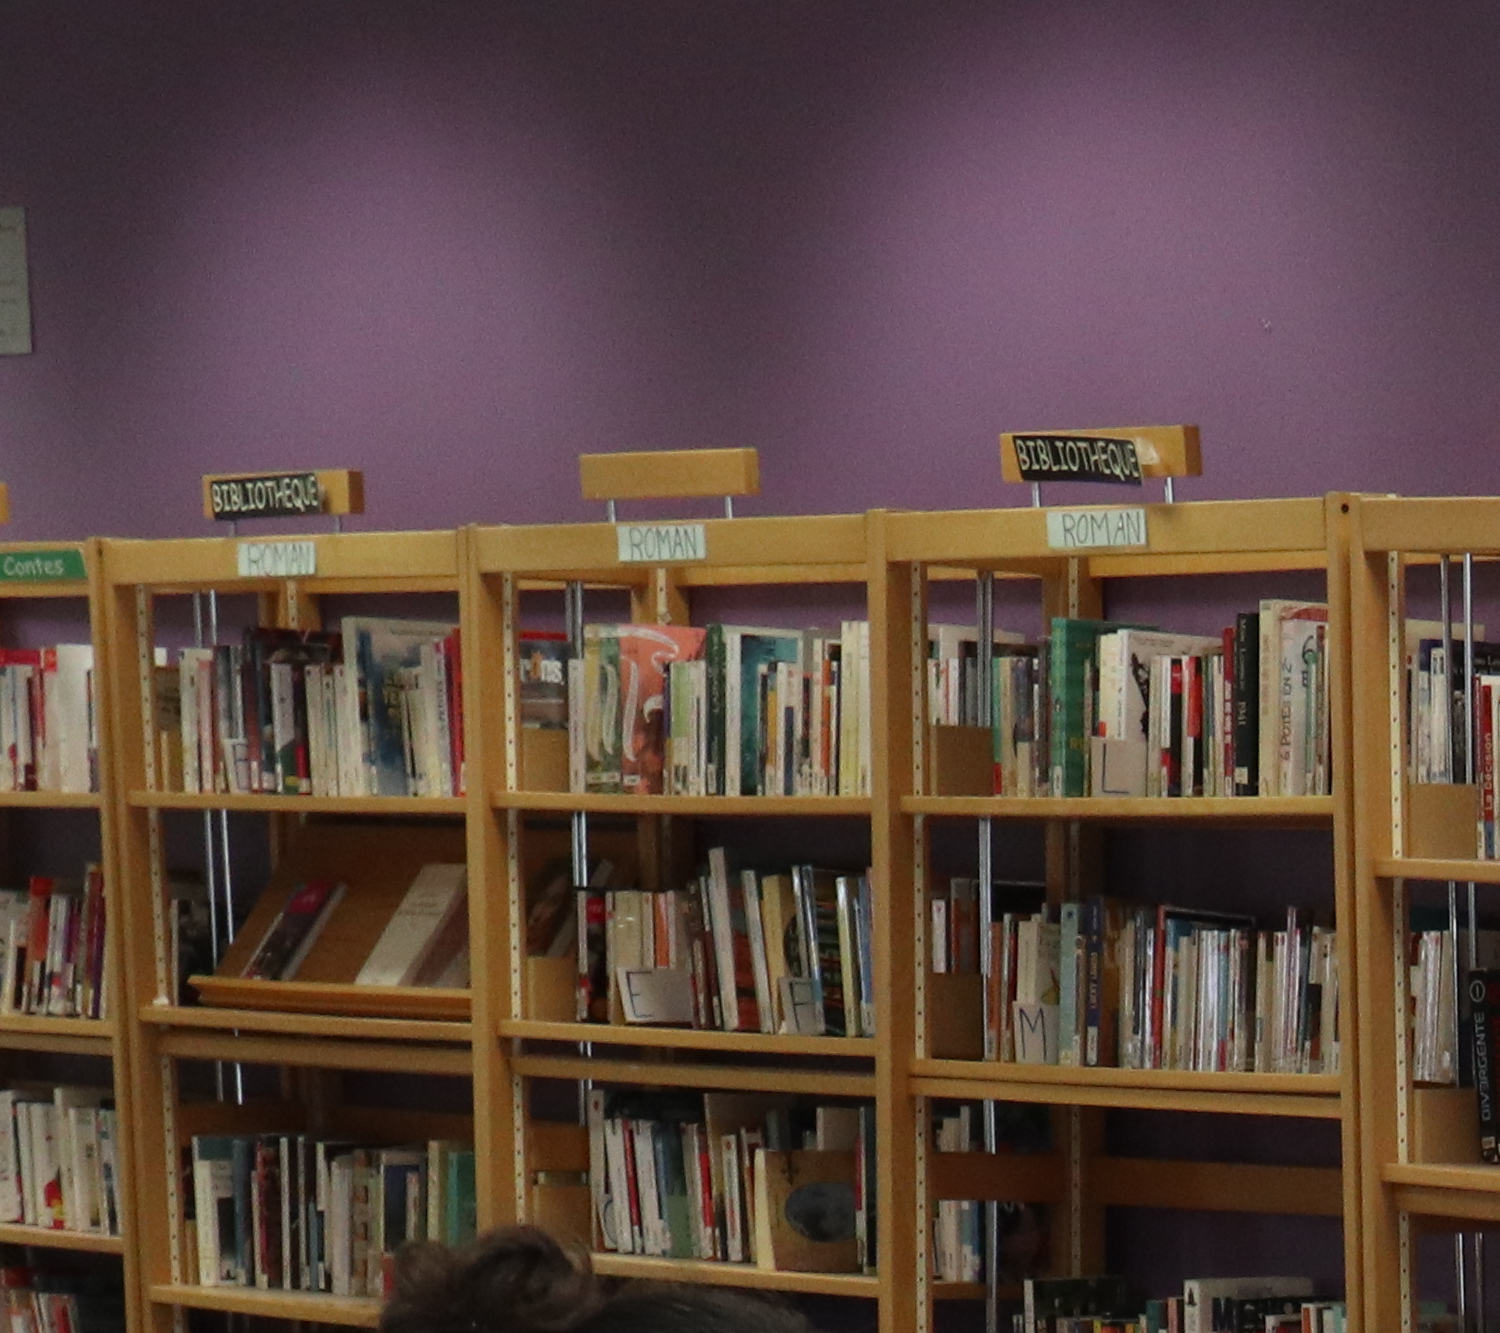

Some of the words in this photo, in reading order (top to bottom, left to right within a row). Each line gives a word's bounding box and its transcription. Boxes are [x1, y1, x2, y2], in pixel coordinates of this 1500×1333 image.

[1016, 437, 1141, 481] BIBLIOTHEQUE
[211, 476, 319, 513] BIBLIOTHEQUE
[628, 526, 698, 560] ROMAN
[1062, 511, 1143, 547] ROMAN
[2, 556, 64, 577] Contes
[246, 542, 316, 574] ROMAN
[1018, 1006, 1048, 1063] M
